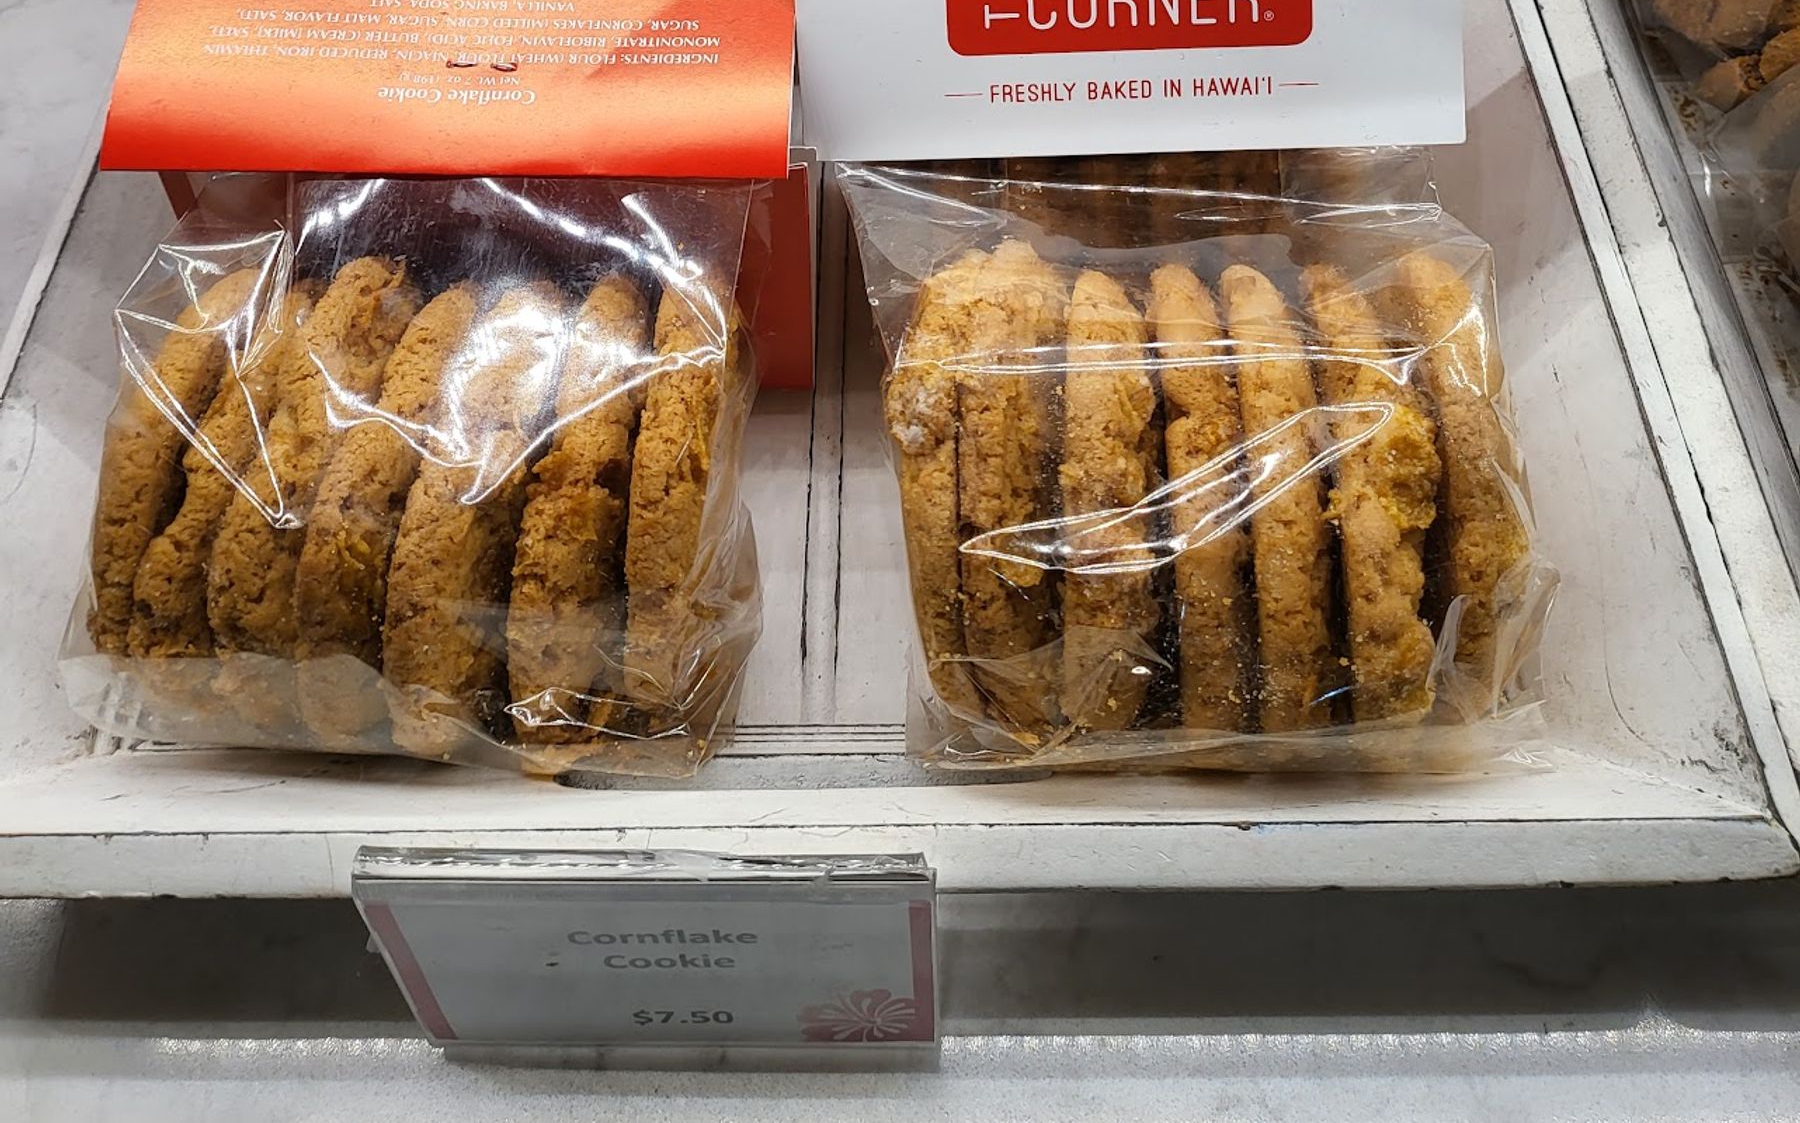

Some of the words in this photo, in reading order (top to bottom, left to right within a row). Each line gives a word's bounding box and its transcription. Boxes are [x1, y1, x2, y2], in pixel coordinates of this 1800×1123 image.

[453, 0, 508, 11] BAKING
[281, 10, 340, 23] FLAVOR,
[343, 13, 381, 24] MALT
[553, 19, 643, 31] CORNFLAKES
[646, 19, 700, 31] SUGAR,
[307, 29, 361, 41] (CREAM
[365, 31, 420, 44] BUTTER
[610, 35, 721, 48] MONONITRATE,
[319, 47, 388, 60] REDUCED
[510, 52, 565, 64] (WHEAT
[569, 53, 616, 65] FLOUR
[620, 53, 719, 65] INGREDIENTS:
[378, 87, 442, 103] Cookie
[447, 89, 536, 106] Cornflake
[990, 82, 1077, 103] FRESHLY
[1088, 80, 1152, 99] BAKED
[1163, 79, 1181, 97] IN
[567, 929, 758, 946] Cornflake
[603, 951, 736, 969] Cookie
[633, 1008, 733, 1027] $7.50
